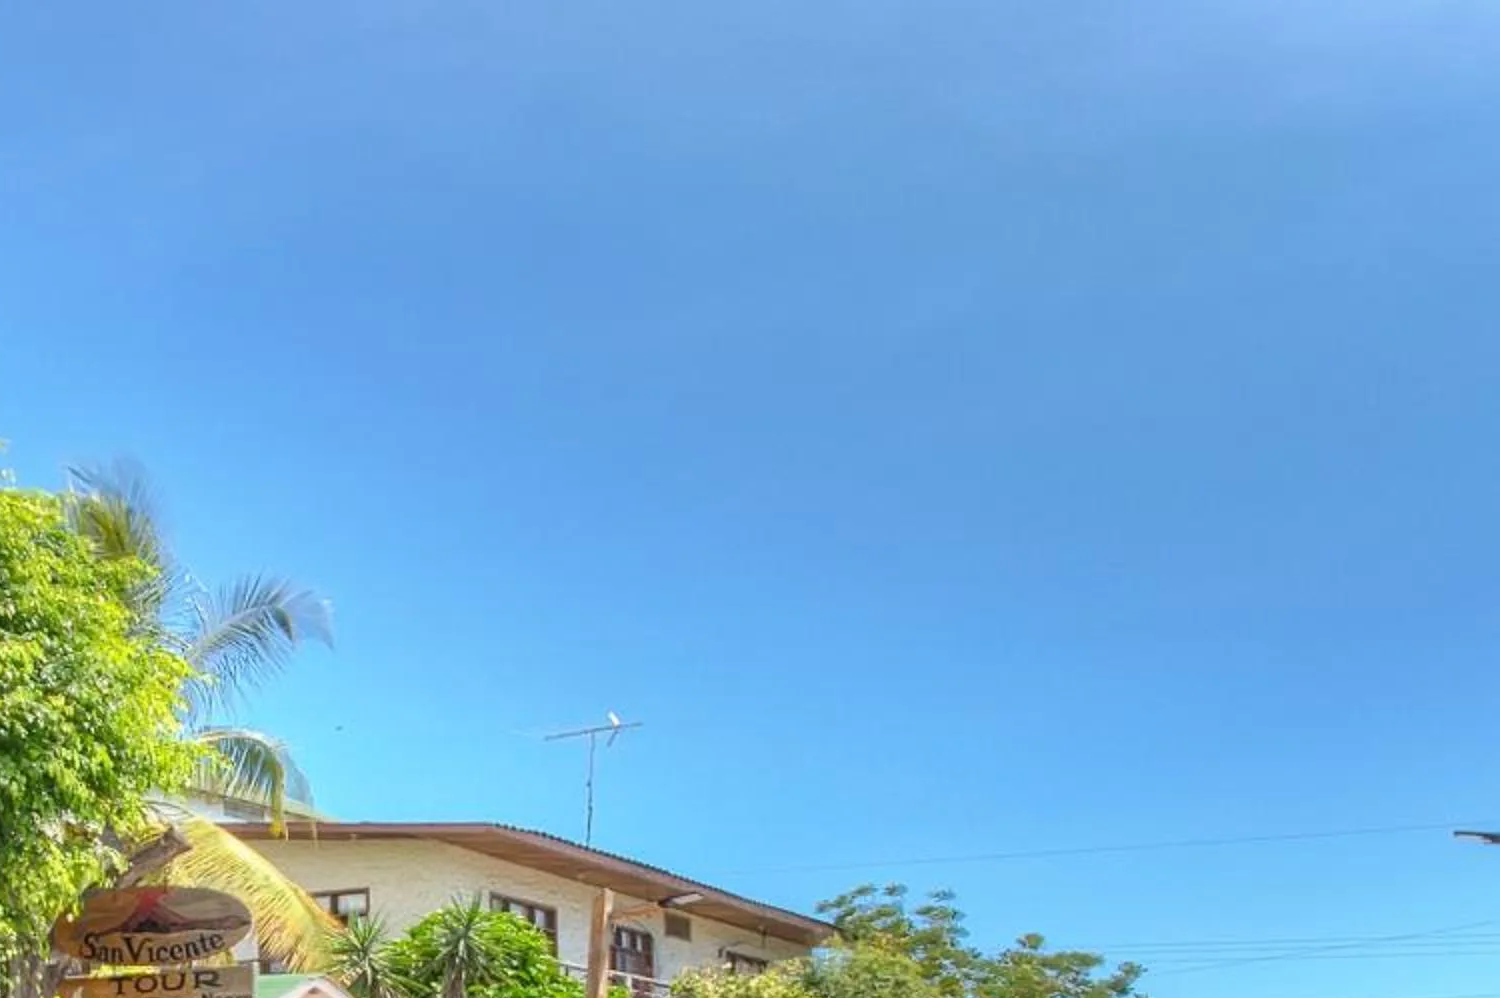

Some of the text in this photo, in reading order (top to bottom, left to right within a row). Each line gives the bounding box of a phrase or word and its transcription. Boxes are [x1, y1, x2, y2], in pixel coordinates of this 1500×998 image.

[83, 932, 226, 963] San Vicente
[112, 970, 222, 995] TOUR
